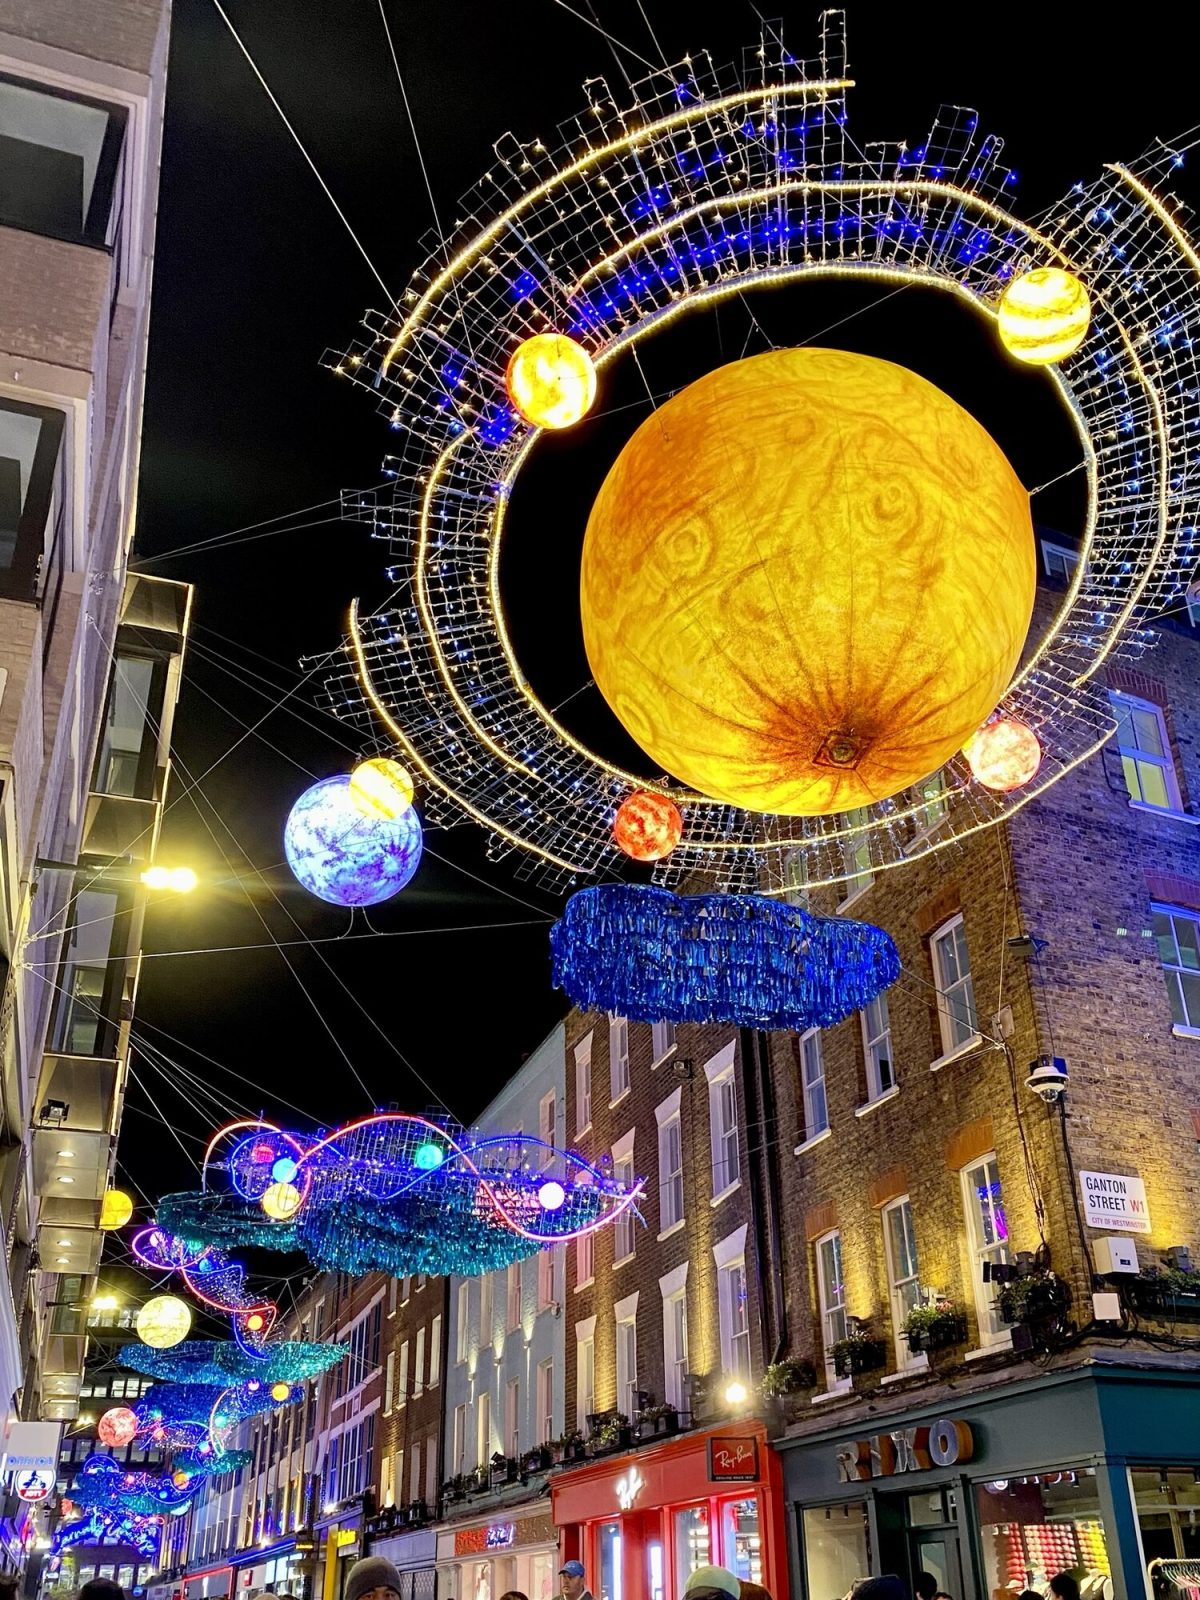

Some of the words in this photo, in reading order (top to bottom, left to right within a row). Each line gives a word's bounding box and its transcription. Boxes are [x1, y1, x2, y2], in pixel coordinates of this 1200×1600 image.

[1086, 1177, 1127, 1194] GANTON
[1089, 1195, 1126, 1211] STREET
[1130, 1199, 1145, 1213] W1
[1091, 1217, 1103, 1225] CITY
[1112, 1219, 1147, 1229] WESTMINSTER
